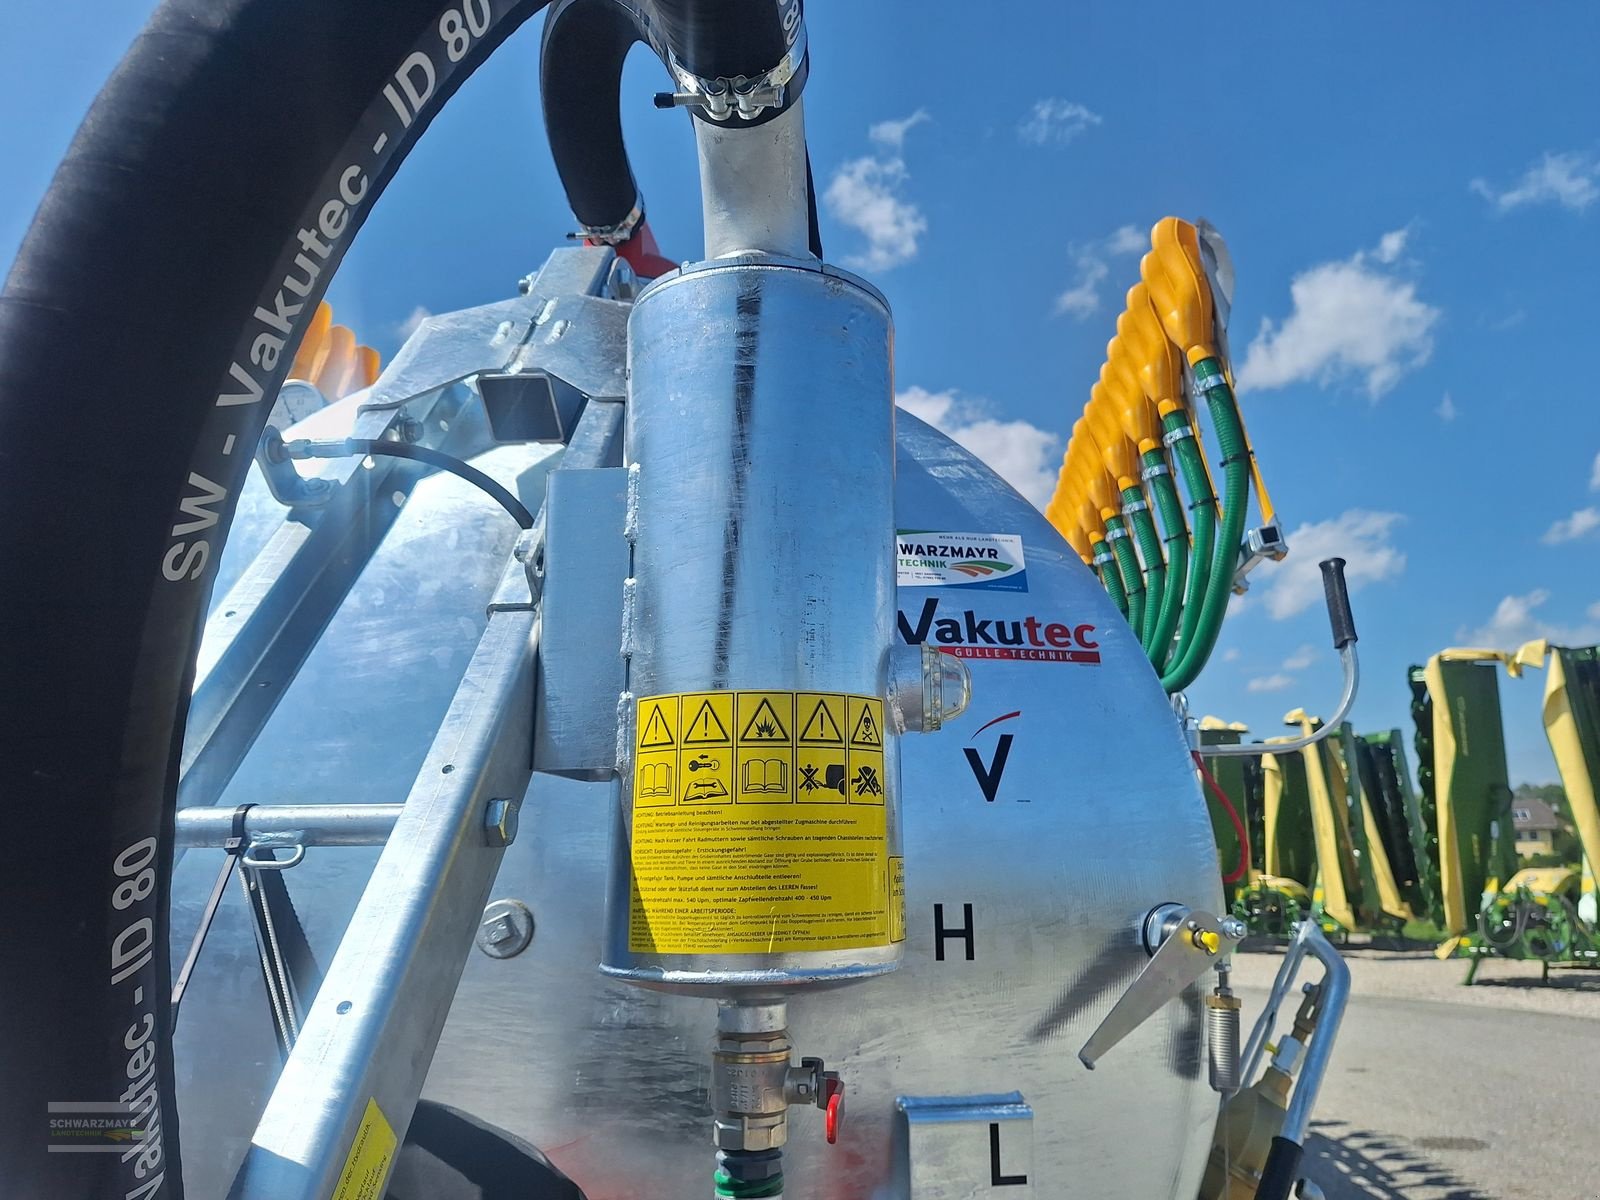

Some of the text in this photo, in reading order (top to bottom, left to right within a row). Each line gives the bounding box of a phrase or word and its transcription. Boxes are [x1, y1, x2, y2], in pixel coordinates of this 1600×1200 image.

[162, 472, 226, 582] SW
[215, 164, 370, 407] Vakutec
[383, 50, 436, 128] ID
[439, 0, 491, 63] 80
[897, 544, 998, 560] WARZMAYR
[898, 558, 947, 568] TECHNIK
[898, 598, 1099, 649] Vakutec
[111, 836, 157, 911] 80
[111, 918, 154, 986] ID
[934, 904, 974, 960] H
[119, 1013, 166, 1200] Vakutec
[990, 1122, 1027, 1186] L
